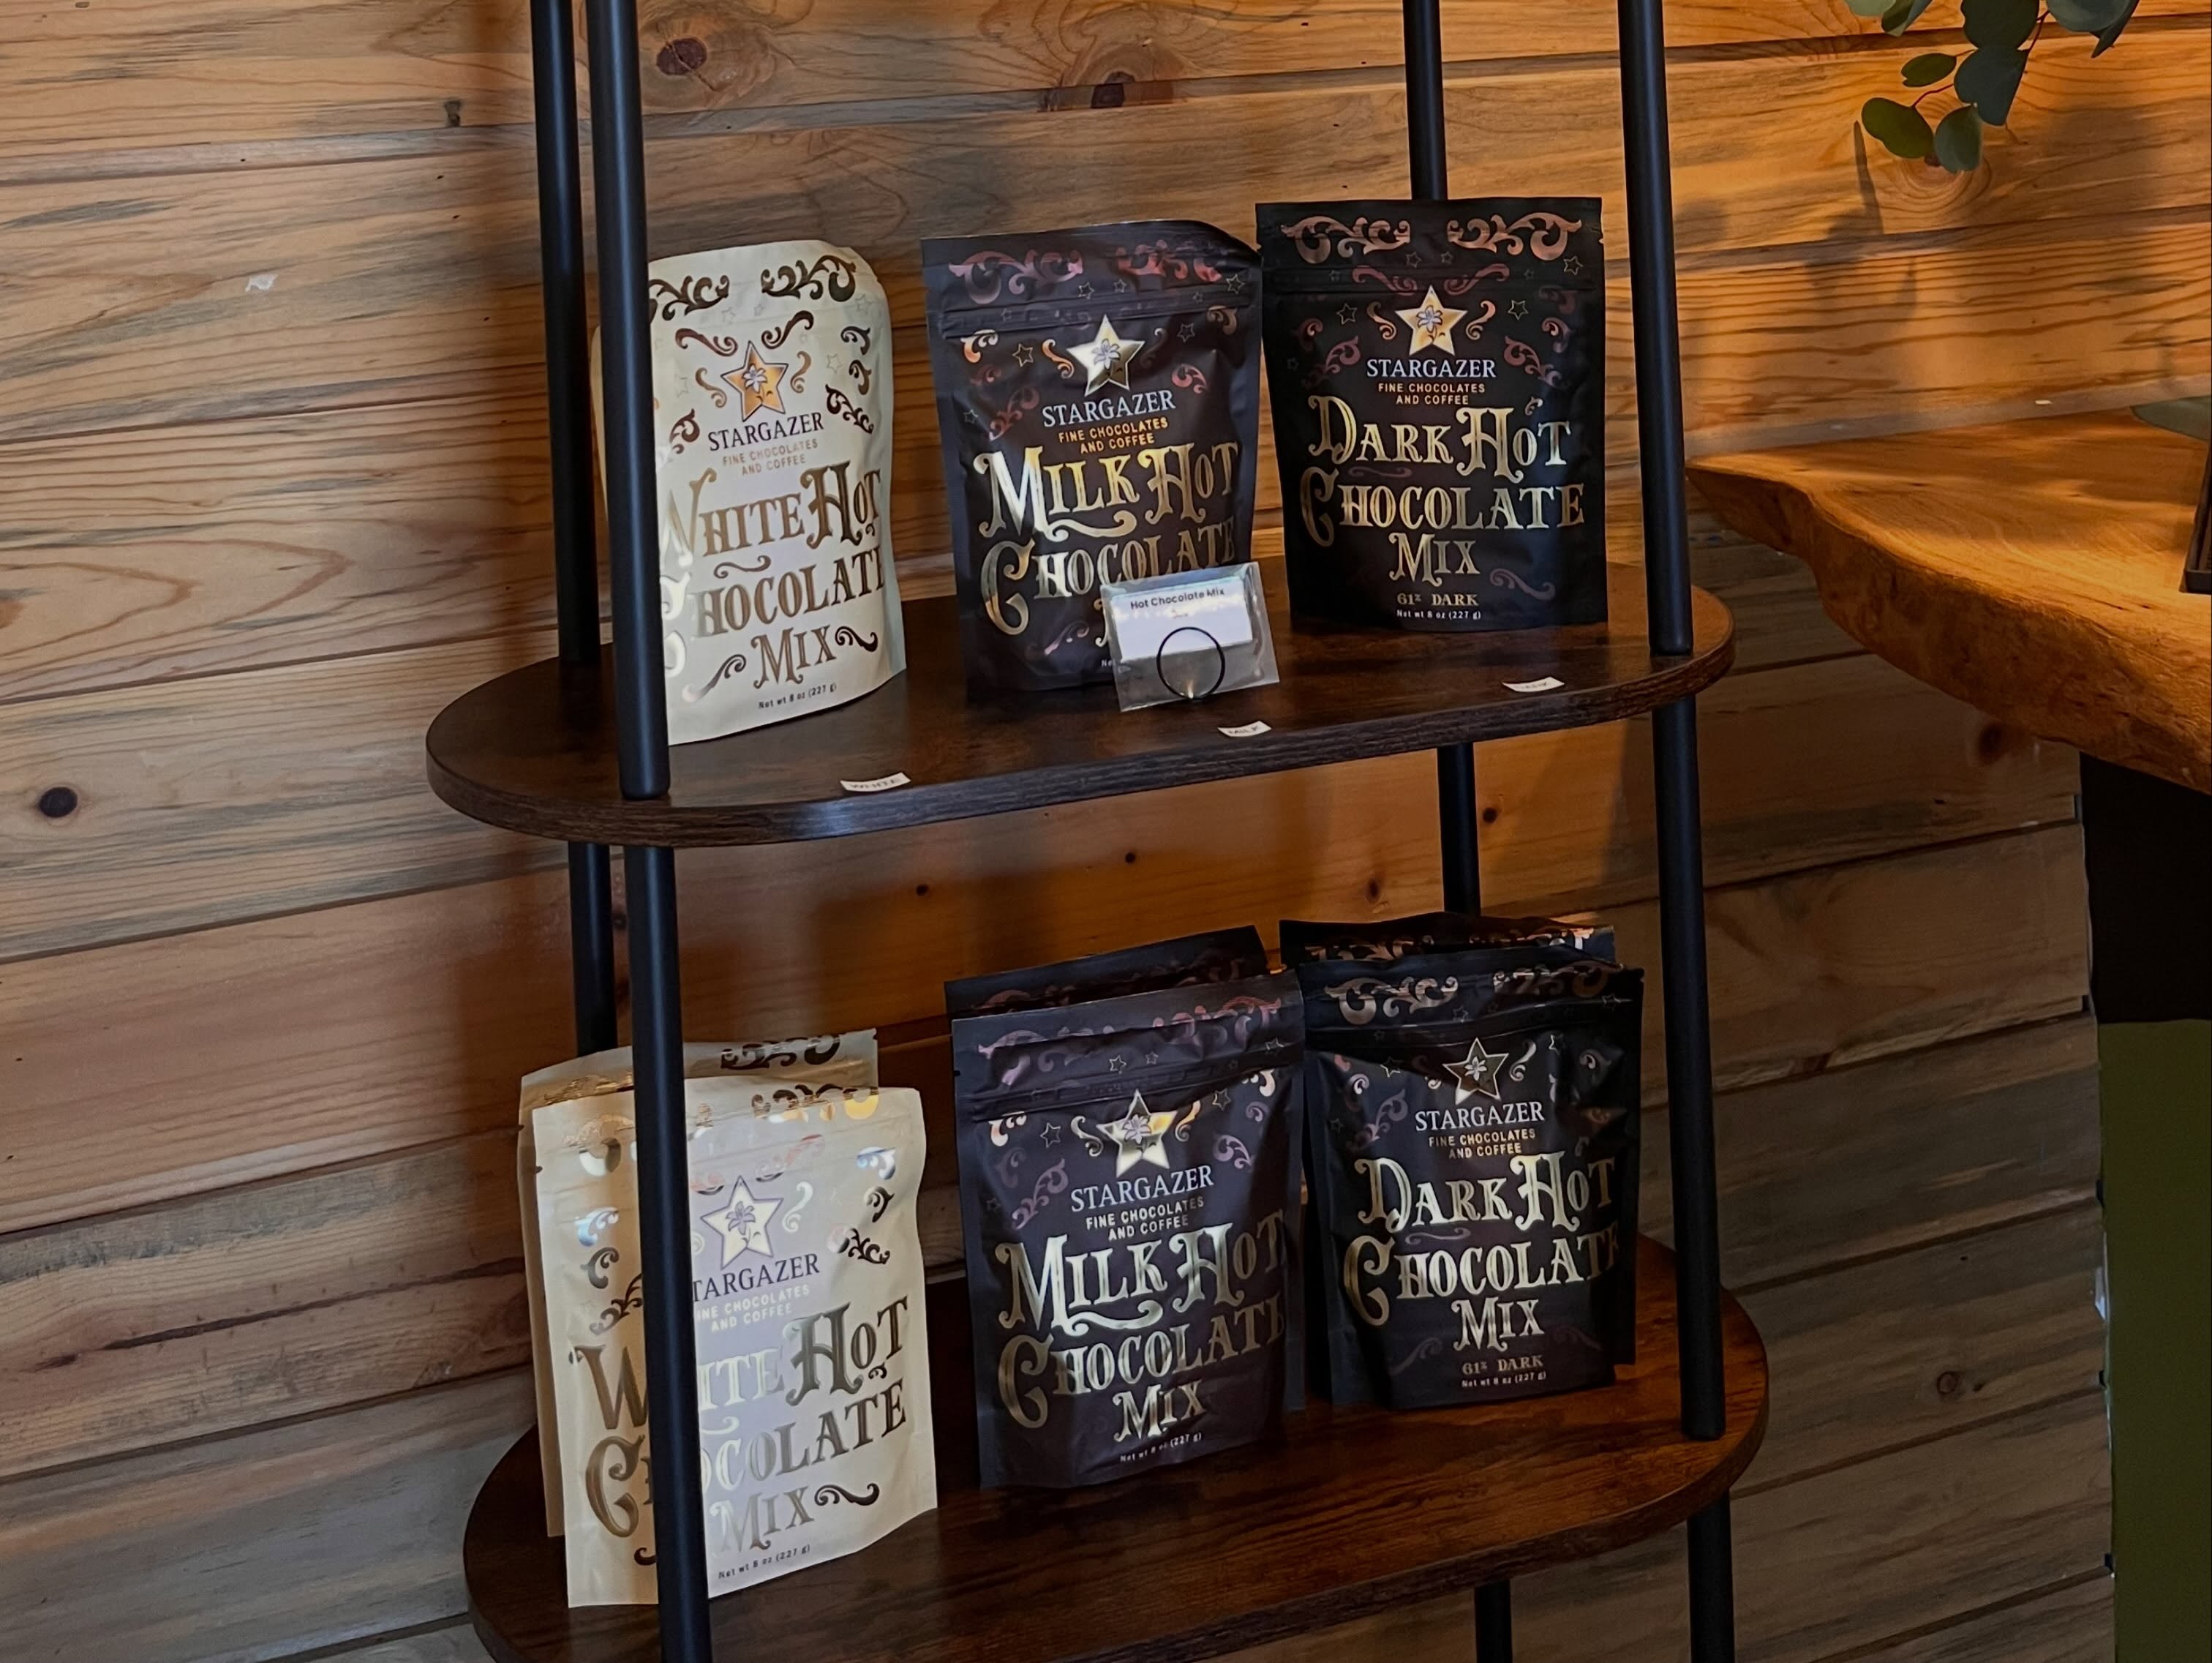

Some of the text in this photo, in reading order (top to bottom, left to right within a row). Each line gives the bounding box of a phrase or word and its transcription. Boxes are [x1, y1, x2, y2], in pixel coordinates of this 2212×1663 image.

[1366, 358, 1497, 378] STARGAZER
[1042, 388, 1175, 428] STARGAZER
[1378, 383, 1486, 394] FINE CHOCOLATES
[1396, 394, 1469, 405] AND COFFEE
[708, 411, 824, 451] STARGAZER
[1058, 416, 1168, 443] FINE CHOCOLATES
[1080, 432, 1154, 455] AND COFFEE
[1308, 395, 1572, 484] DARK HOT
[723, 438, 819, 466] FINE CHOCOLATES
[742, 454, 806, 476] AND COFFEE
[800, 459, 881, 549] HOT
[973, 440, 1239, 542] MILK HOT
[1300, 466, 1586, 547] CHOCOLATE
[980, 516, 1235, 636] CHOCOLATE
[1388, 531, 1481, 587] MIX
[1130, 588, 1224, 610] Hot Chocolate Mix
[1431, 593, 1479, 607] DARK
[750, 625, 837, 689] MIX
[1415, 1101, 1545, 1132] STARGAZER
[1429, 1128, 1536, 1147] FINE CHOCOLATES
[1448, 1142, 1522, 1159] AND COFFEE
[1070, 1164, 1215, 1212] STARGAZER
[1354, 1150, 1615, 1234] DARK HOT
[1086, 1196, 1204, 1231] FINE CHOCOLATES
[1107, 1215, 1189, 1241] AND COFFEE
[693, 1253, 820, 1302] TARGAZER
[995, 1209, 1283, 1337] MILK HOT
[694, 1284, 810, 1323] INE CHOCOLATES
[712, 1302, 793, 1332] AND COFFEE
[1451, 1296, 1545, 1351] MIX
[568, 1296, 908, 1430] WITE HOT
[1497, 1354, 1543, 1371] DARK
[1113, 1380, 1208, 1443] MIX
[585, 1378, 906, 1538] CCOLATE
[710, 1485, 815, 1555] MIX
